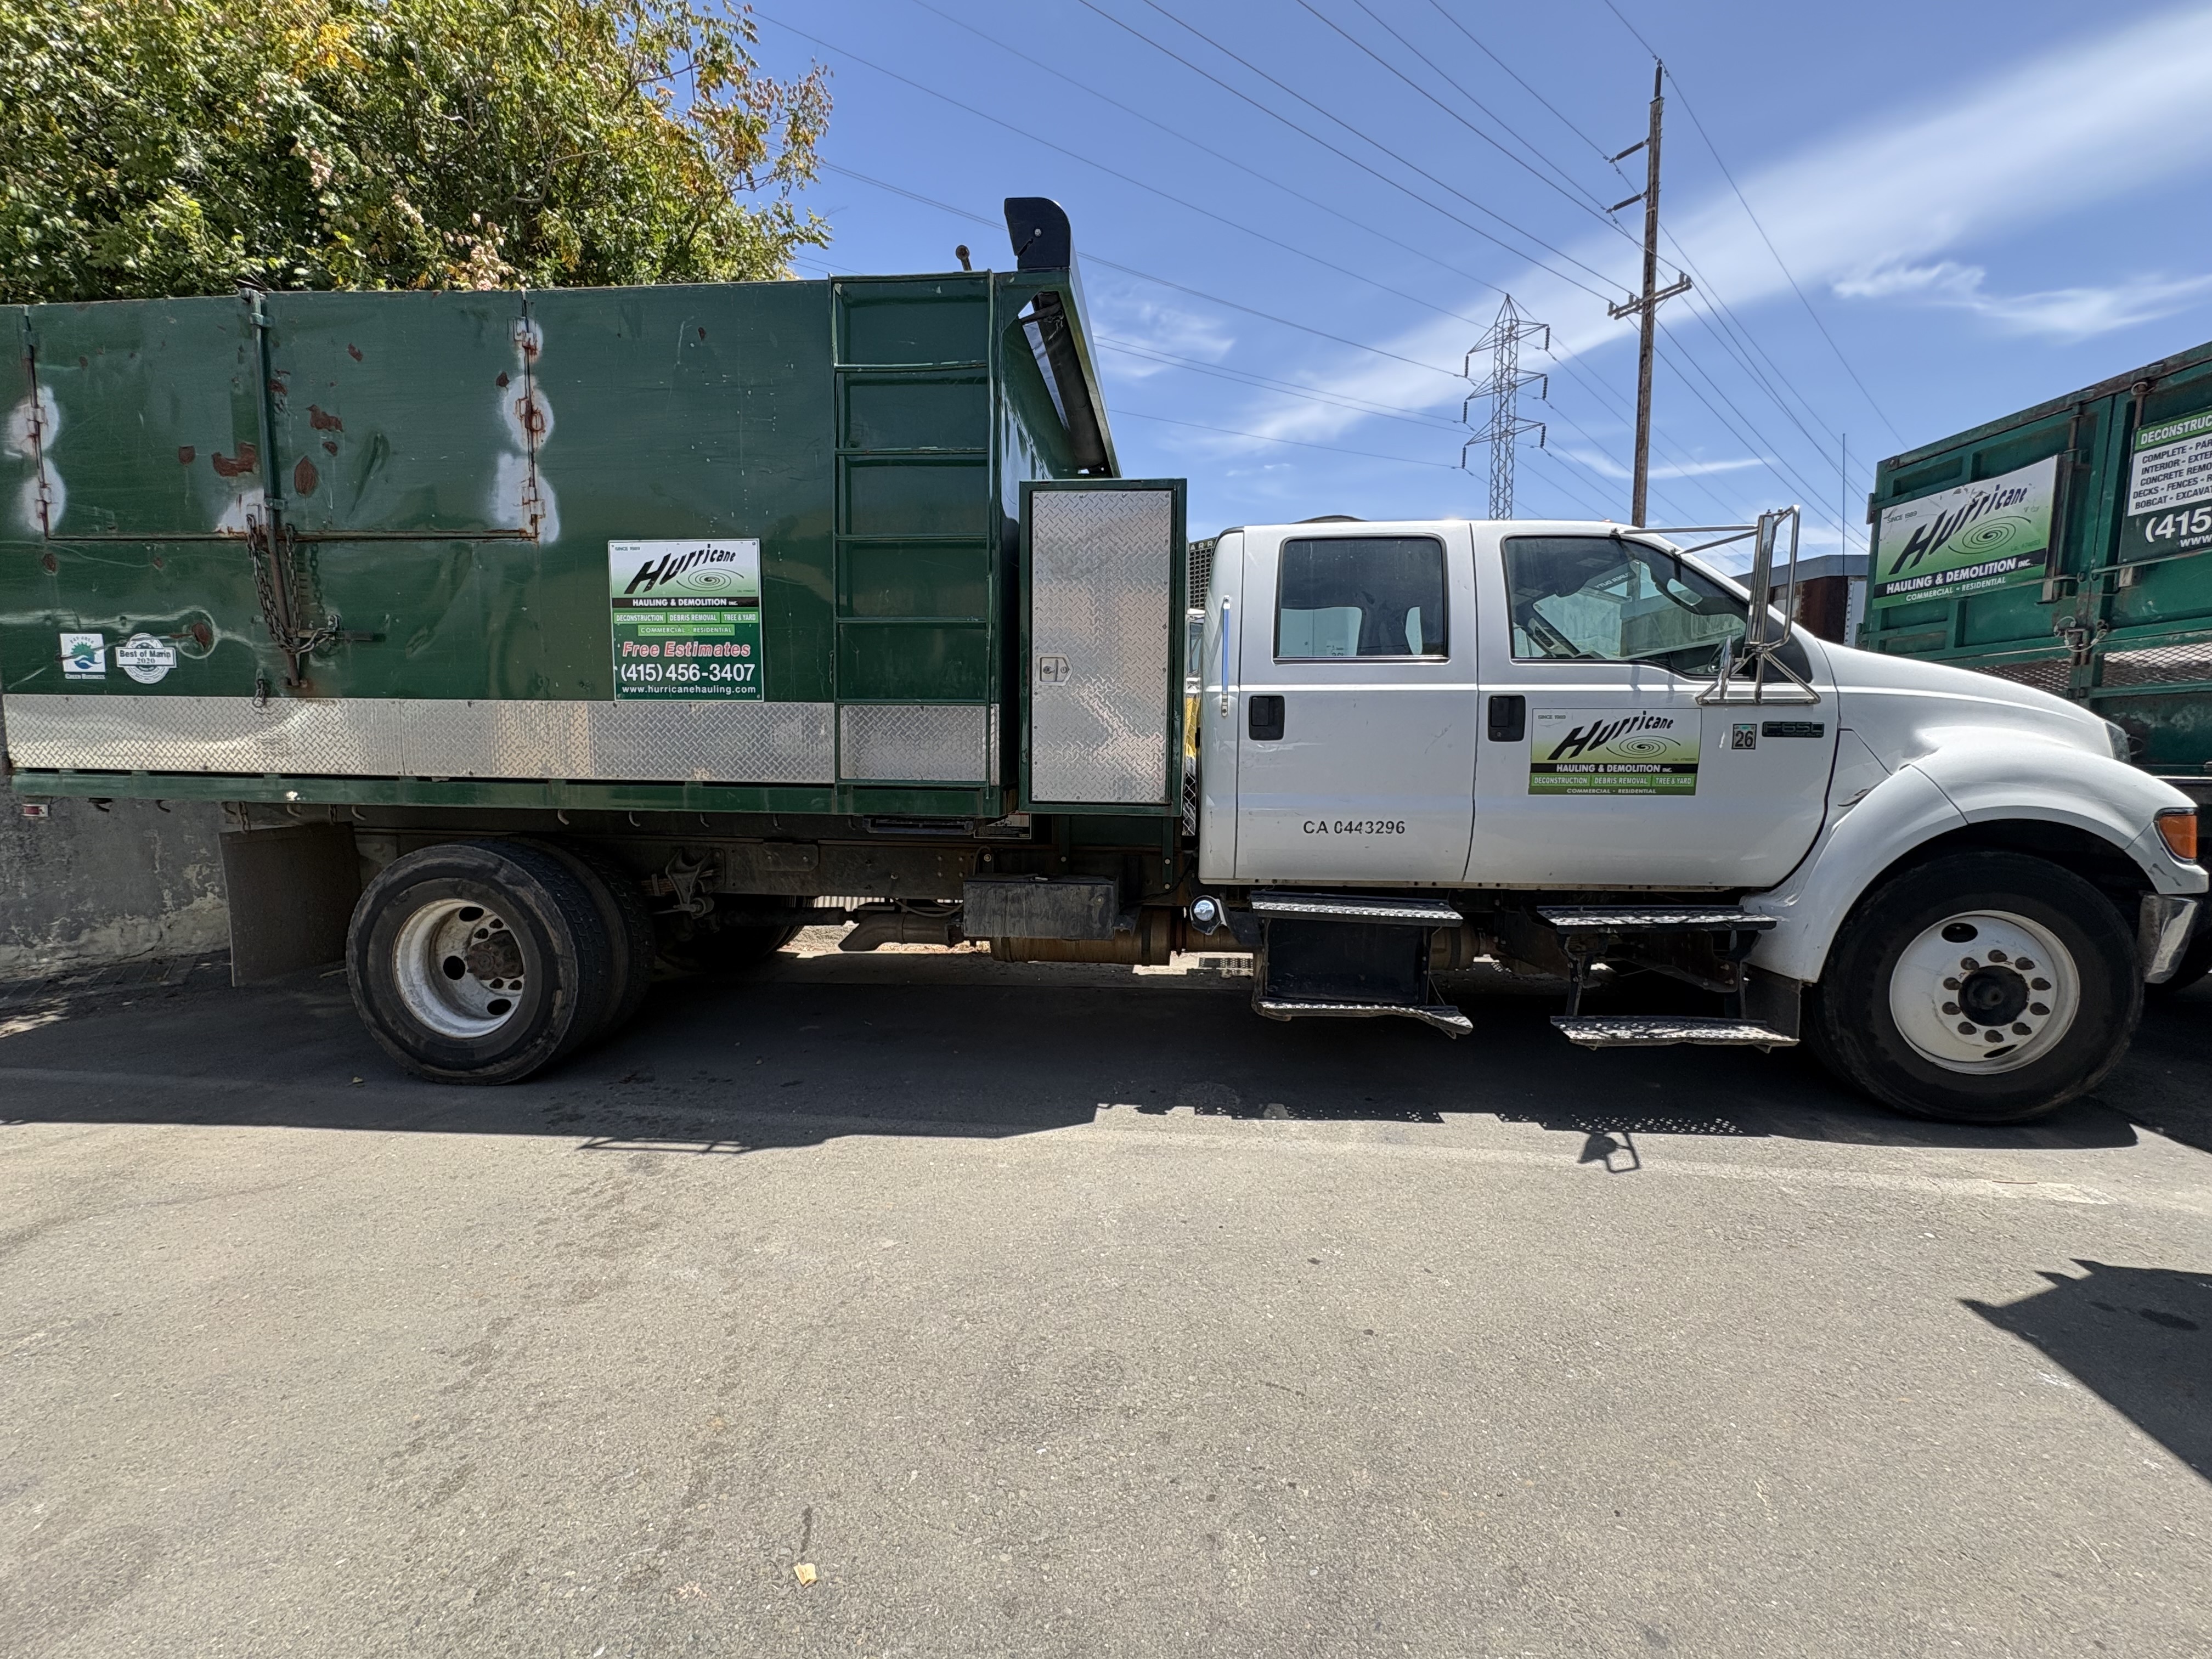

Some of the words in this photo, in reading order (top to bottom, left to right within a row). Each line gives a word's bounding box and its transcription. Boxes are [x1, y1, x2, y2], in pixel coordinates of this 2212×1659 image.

[2141, 415, 2212, 445] DECONSTRUC
[2142, 445, 2187, 464] COMPLETE
[2141, 459, 2181, 475] INTERIOR
[2141, 469, 2184, 487] CONCRETE
[2133, 487, 2159, 499] DECKS
[2166, 477, 2198, 492] FENCES
[2135, 495, 2169, 510] BOBCAT
[1887, 514, 1903, 523] SINCE
[1888, 484, 2028, 575] Hurricane
[624, 544, 736, 594] Hurricane
[1886, 576, 1932, 594] HAULING
[1935, 575, 1944, 585] &
[1946, 558, 2017, 583] DEMOLITION
[1906, 588, 1954, 602] COMMERCIAL
[1962, 577, 2006, 591] RESIDENTIAL
[623, 641, 659, 657] Free
[664, 641, 751, 657] Estimates
[620, 664, 663, 681] (415)
[665, 663, 755, 681] 456-3407
[622, 685, 756, 695] www.hurricanehauling.com
[1547, 710, 1674, 760] Hurricane
[1735, 730, 1753, 747] 26
[1303, 821, 1329, 834] CA
[1334, 821, 1405, 834] 0443296
